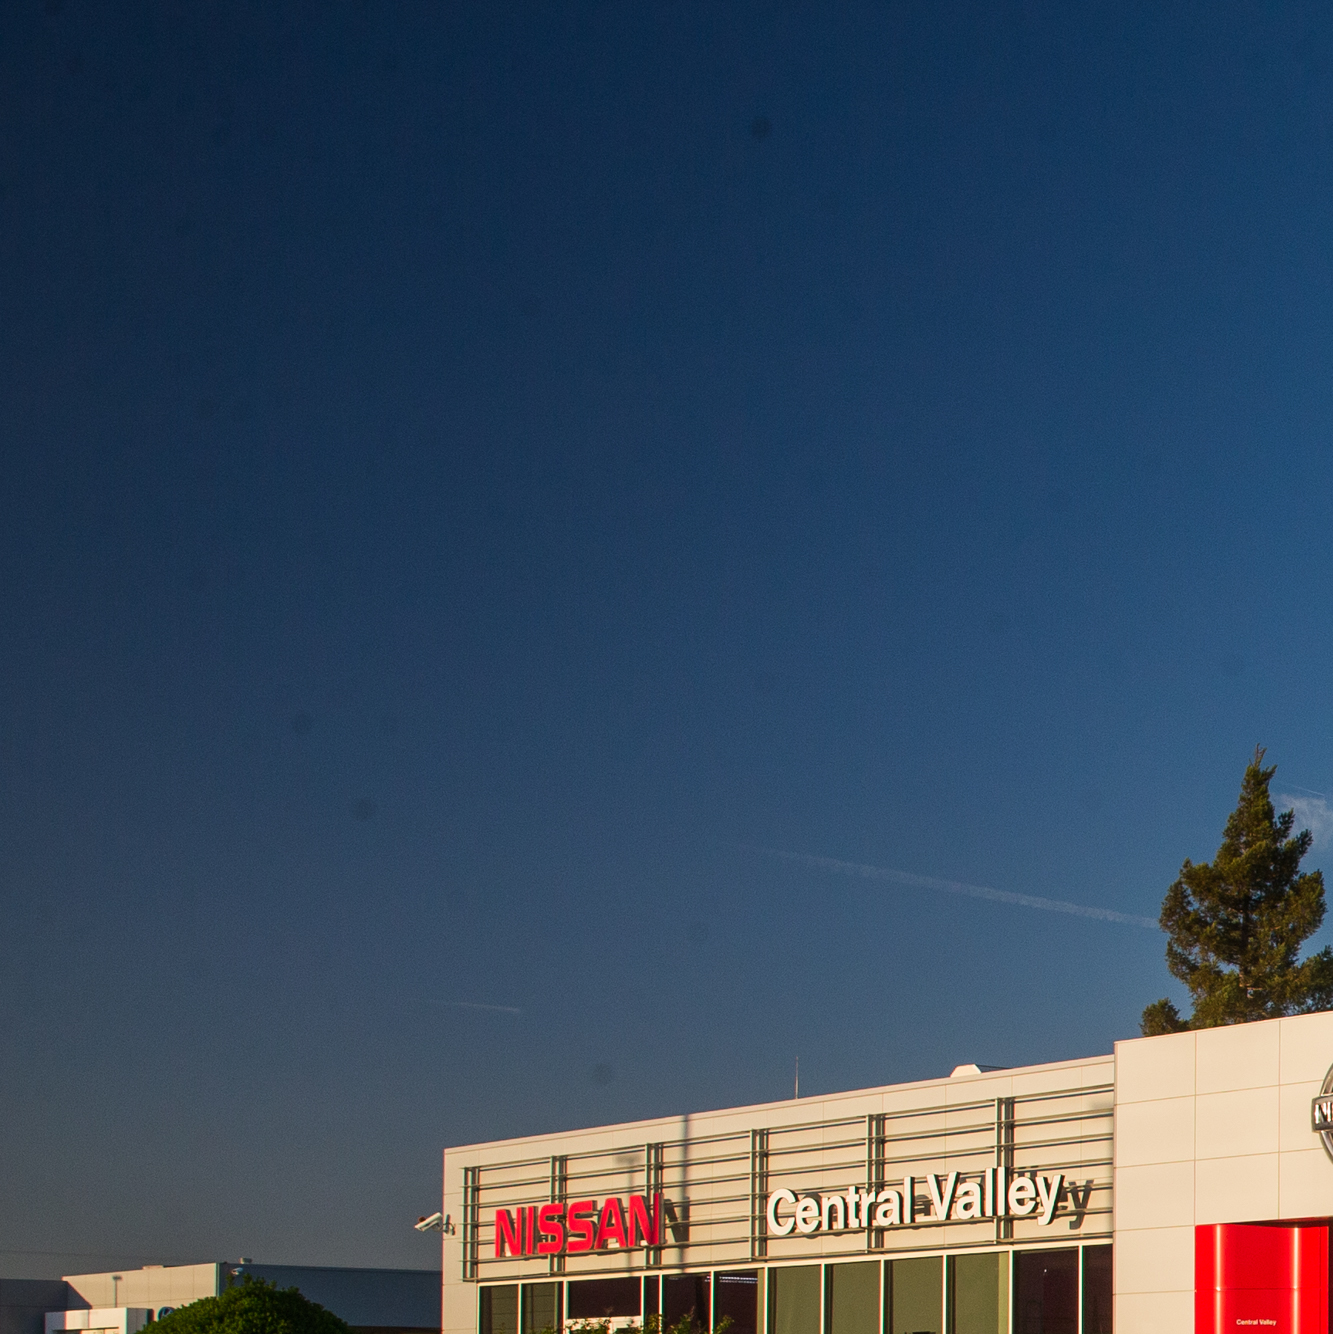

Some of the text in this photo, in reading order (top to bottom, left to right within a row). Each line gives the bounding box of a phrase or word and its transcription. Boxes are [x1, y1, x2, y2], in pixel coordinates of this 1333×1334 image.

[495, 1193, 661, 1258] NISSAN
[767, 1166, 1064, 1236] Central Valley
[1259, 1319, 1277, 1327] Valley
